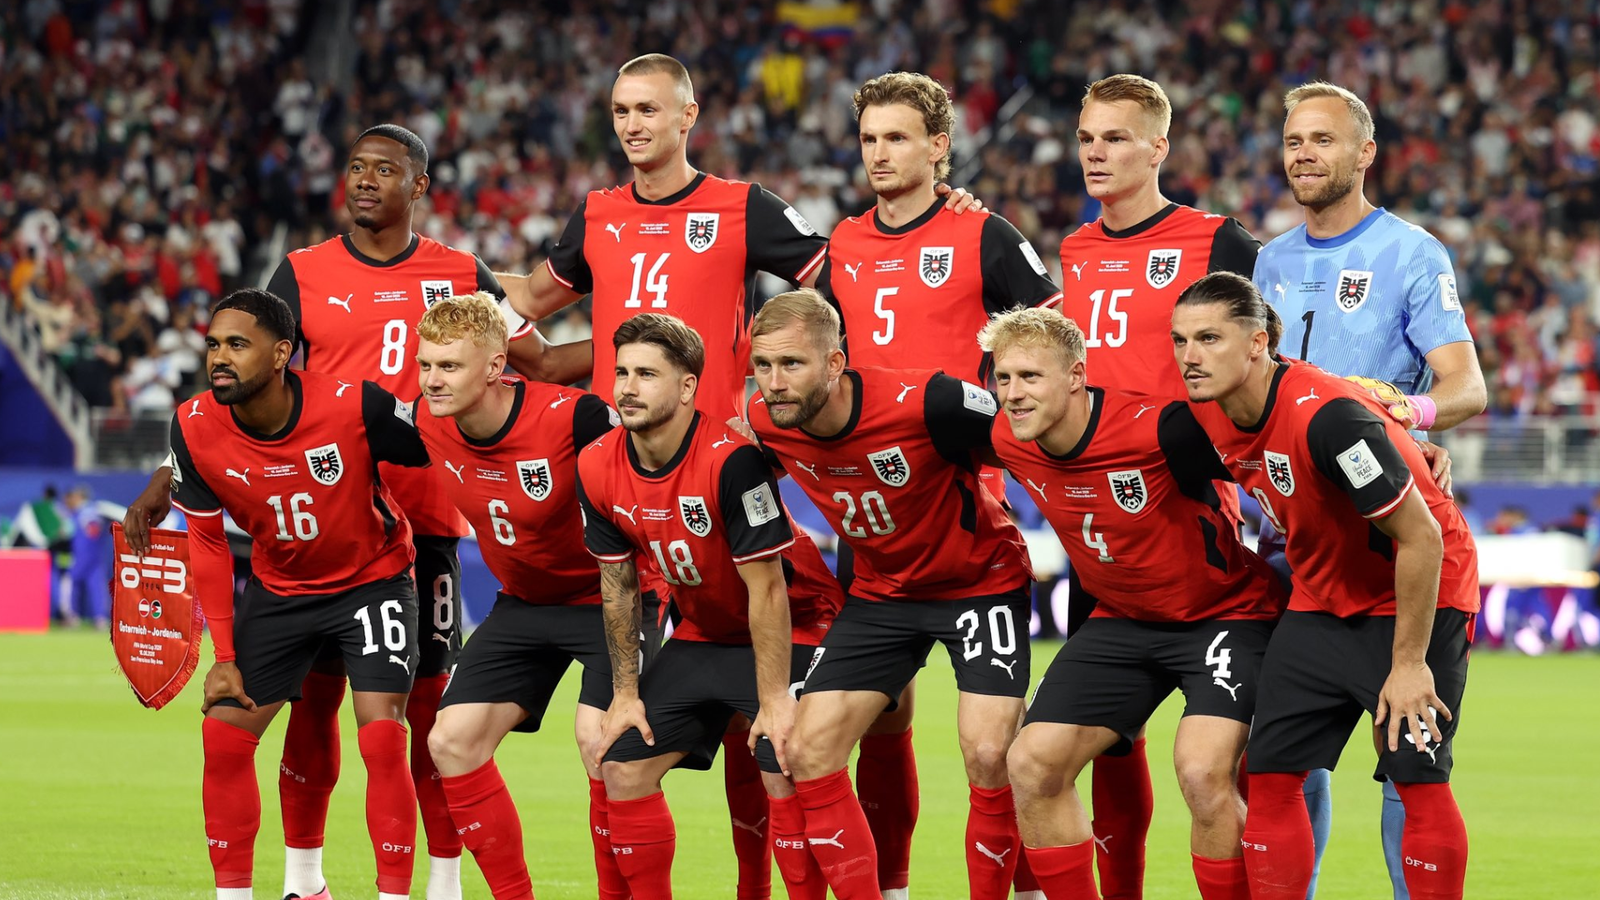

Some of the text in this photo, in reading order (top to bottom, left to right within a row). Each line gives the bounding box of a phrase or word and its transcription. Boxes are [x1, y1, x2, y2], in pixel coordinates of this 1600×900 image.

[625, 252, 670, 308] 14
[872, 286, 899, 345] 5
[1085, 288, 1134, 348] 15
[1300, 310, 1316, 364] 1
[380, 319, 407, 375] 8
[266, 491, 319, 541] 16
[487, 499, 516, 547] 6
[832, 490, 896, 537] 20
[1081, 513, 1114, 563] 4
[649, 540, 703, 586] 18
[433, 573, 454, 630] 8
[119, 620, 147, 635] Österreich
[152, 627, 182, 639] Jordanien
[353, 599, 407, 656] 16
[955, 604, 1017, 662] 20
[1205, 630, 1232, 679] 4
[382, 842, 413, 854] ÖFB
[775, 837, 805, 849] ÖFB
[1405, 855, 1437, 872] ÖFB
